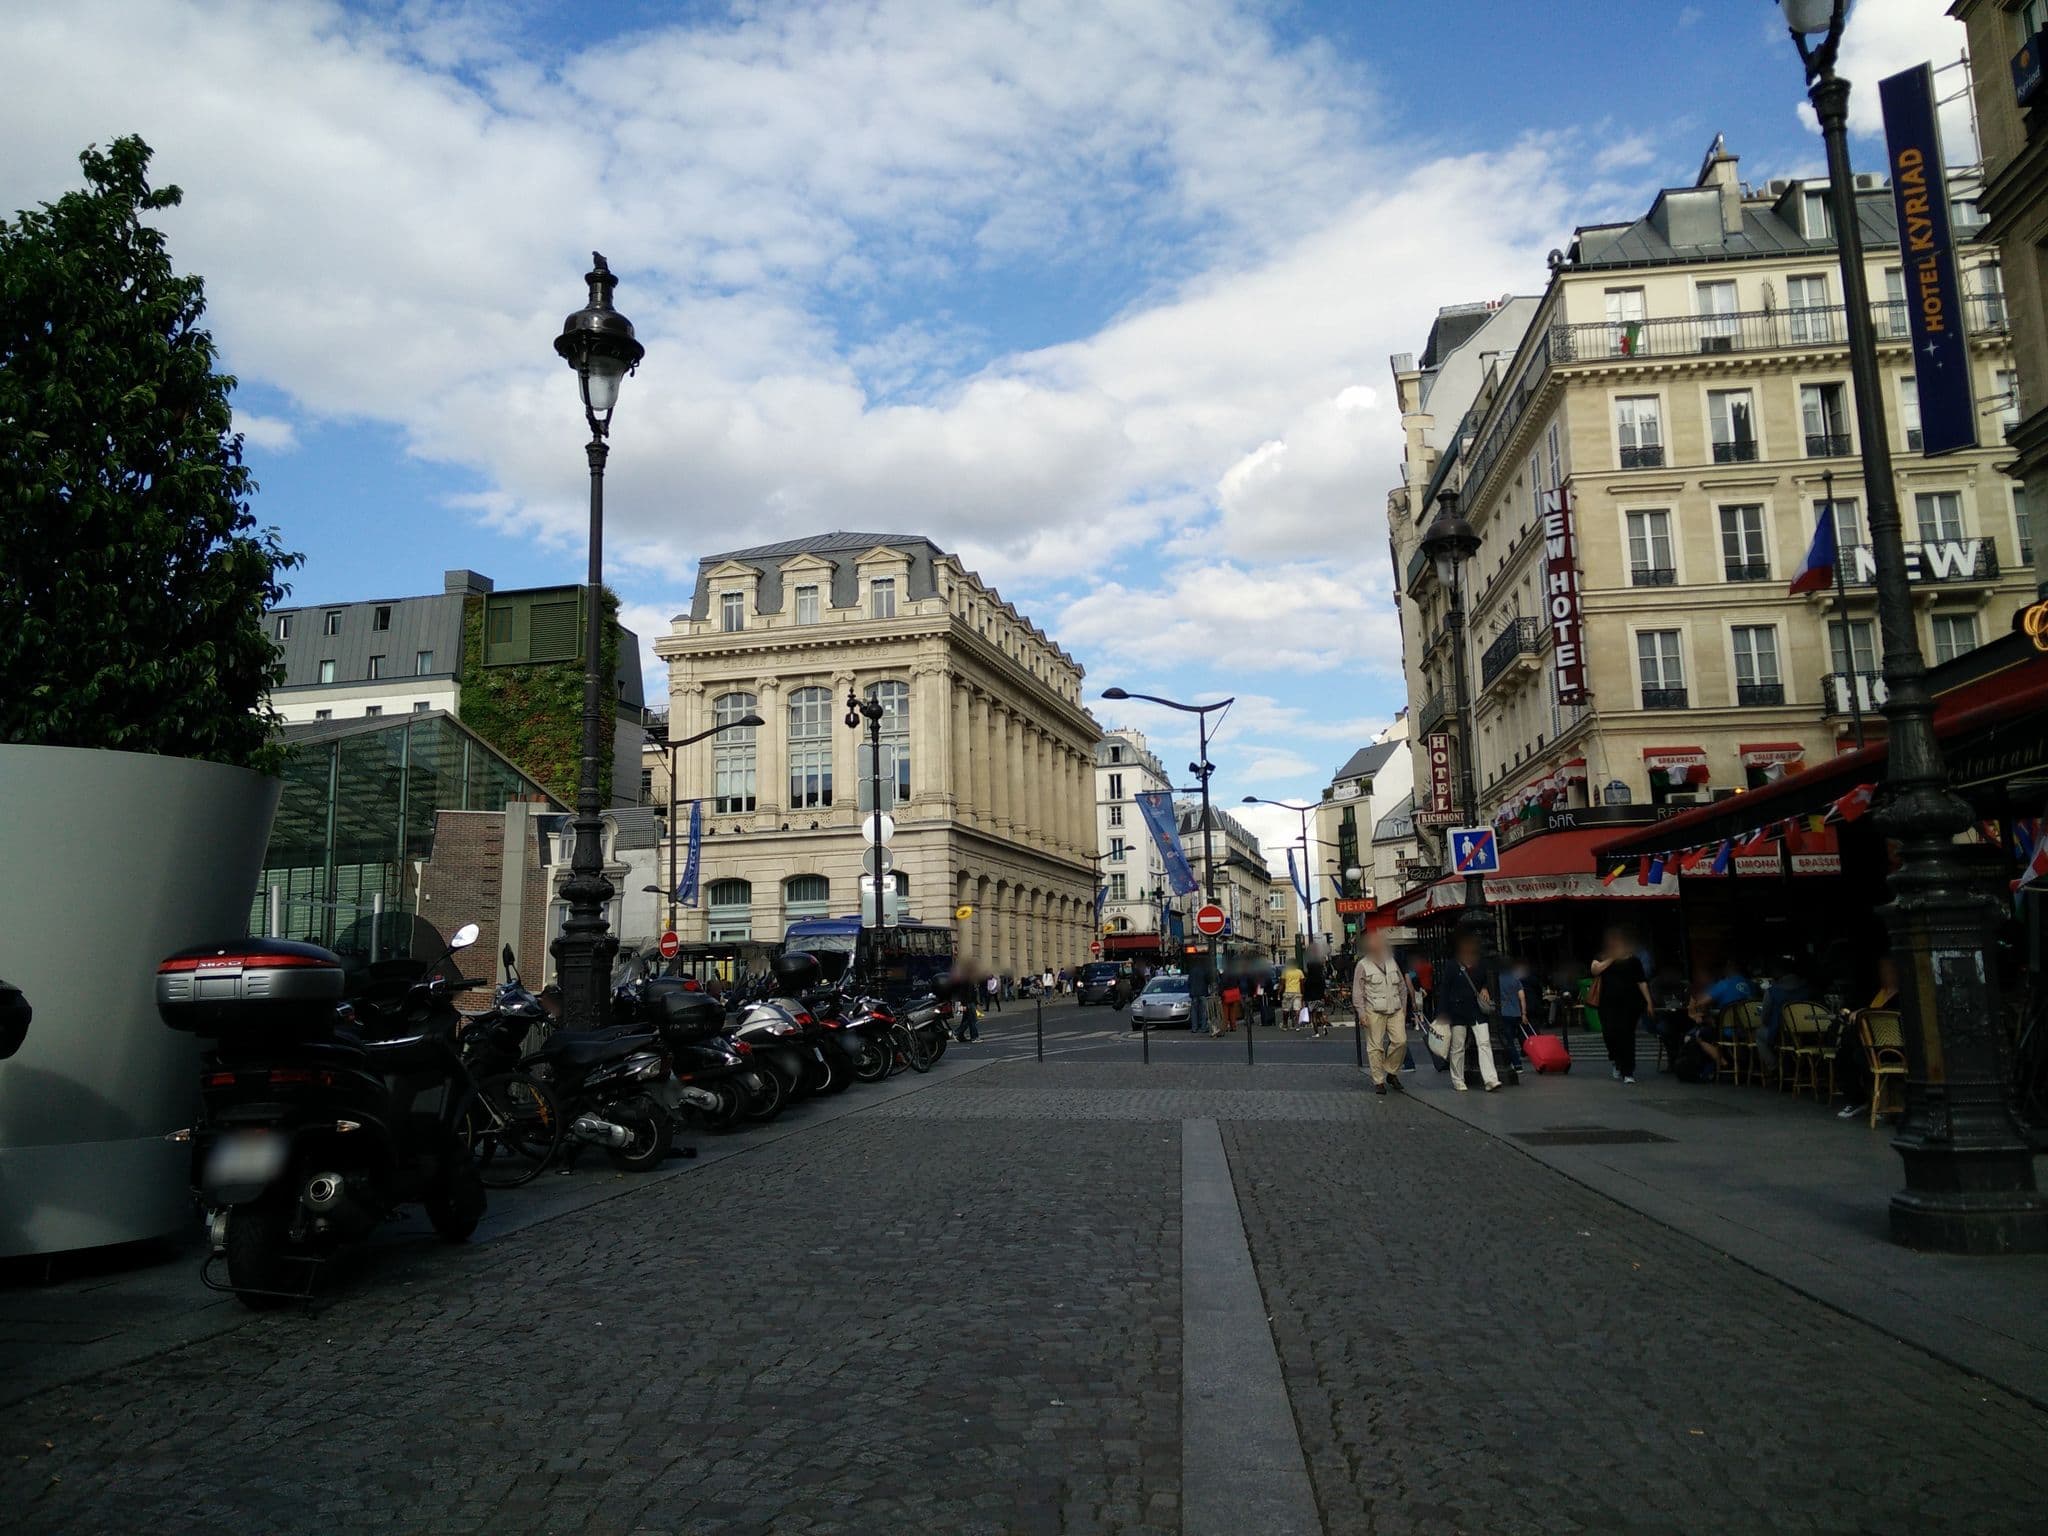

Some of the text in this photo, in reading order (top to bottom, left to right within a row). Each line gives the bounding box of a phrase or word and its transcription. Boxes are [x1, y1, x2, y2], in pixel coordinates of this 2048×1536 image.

[1899, 148, 1945, 331] HOTEL KYRIAD
[1543, 489, 1578, 693] NEW HOTEL
[1855, 540, 1981, 583] NEW
[1432, 736, 1449, 811] HOTEL
[1548, 813, 1577, 831] BAR
